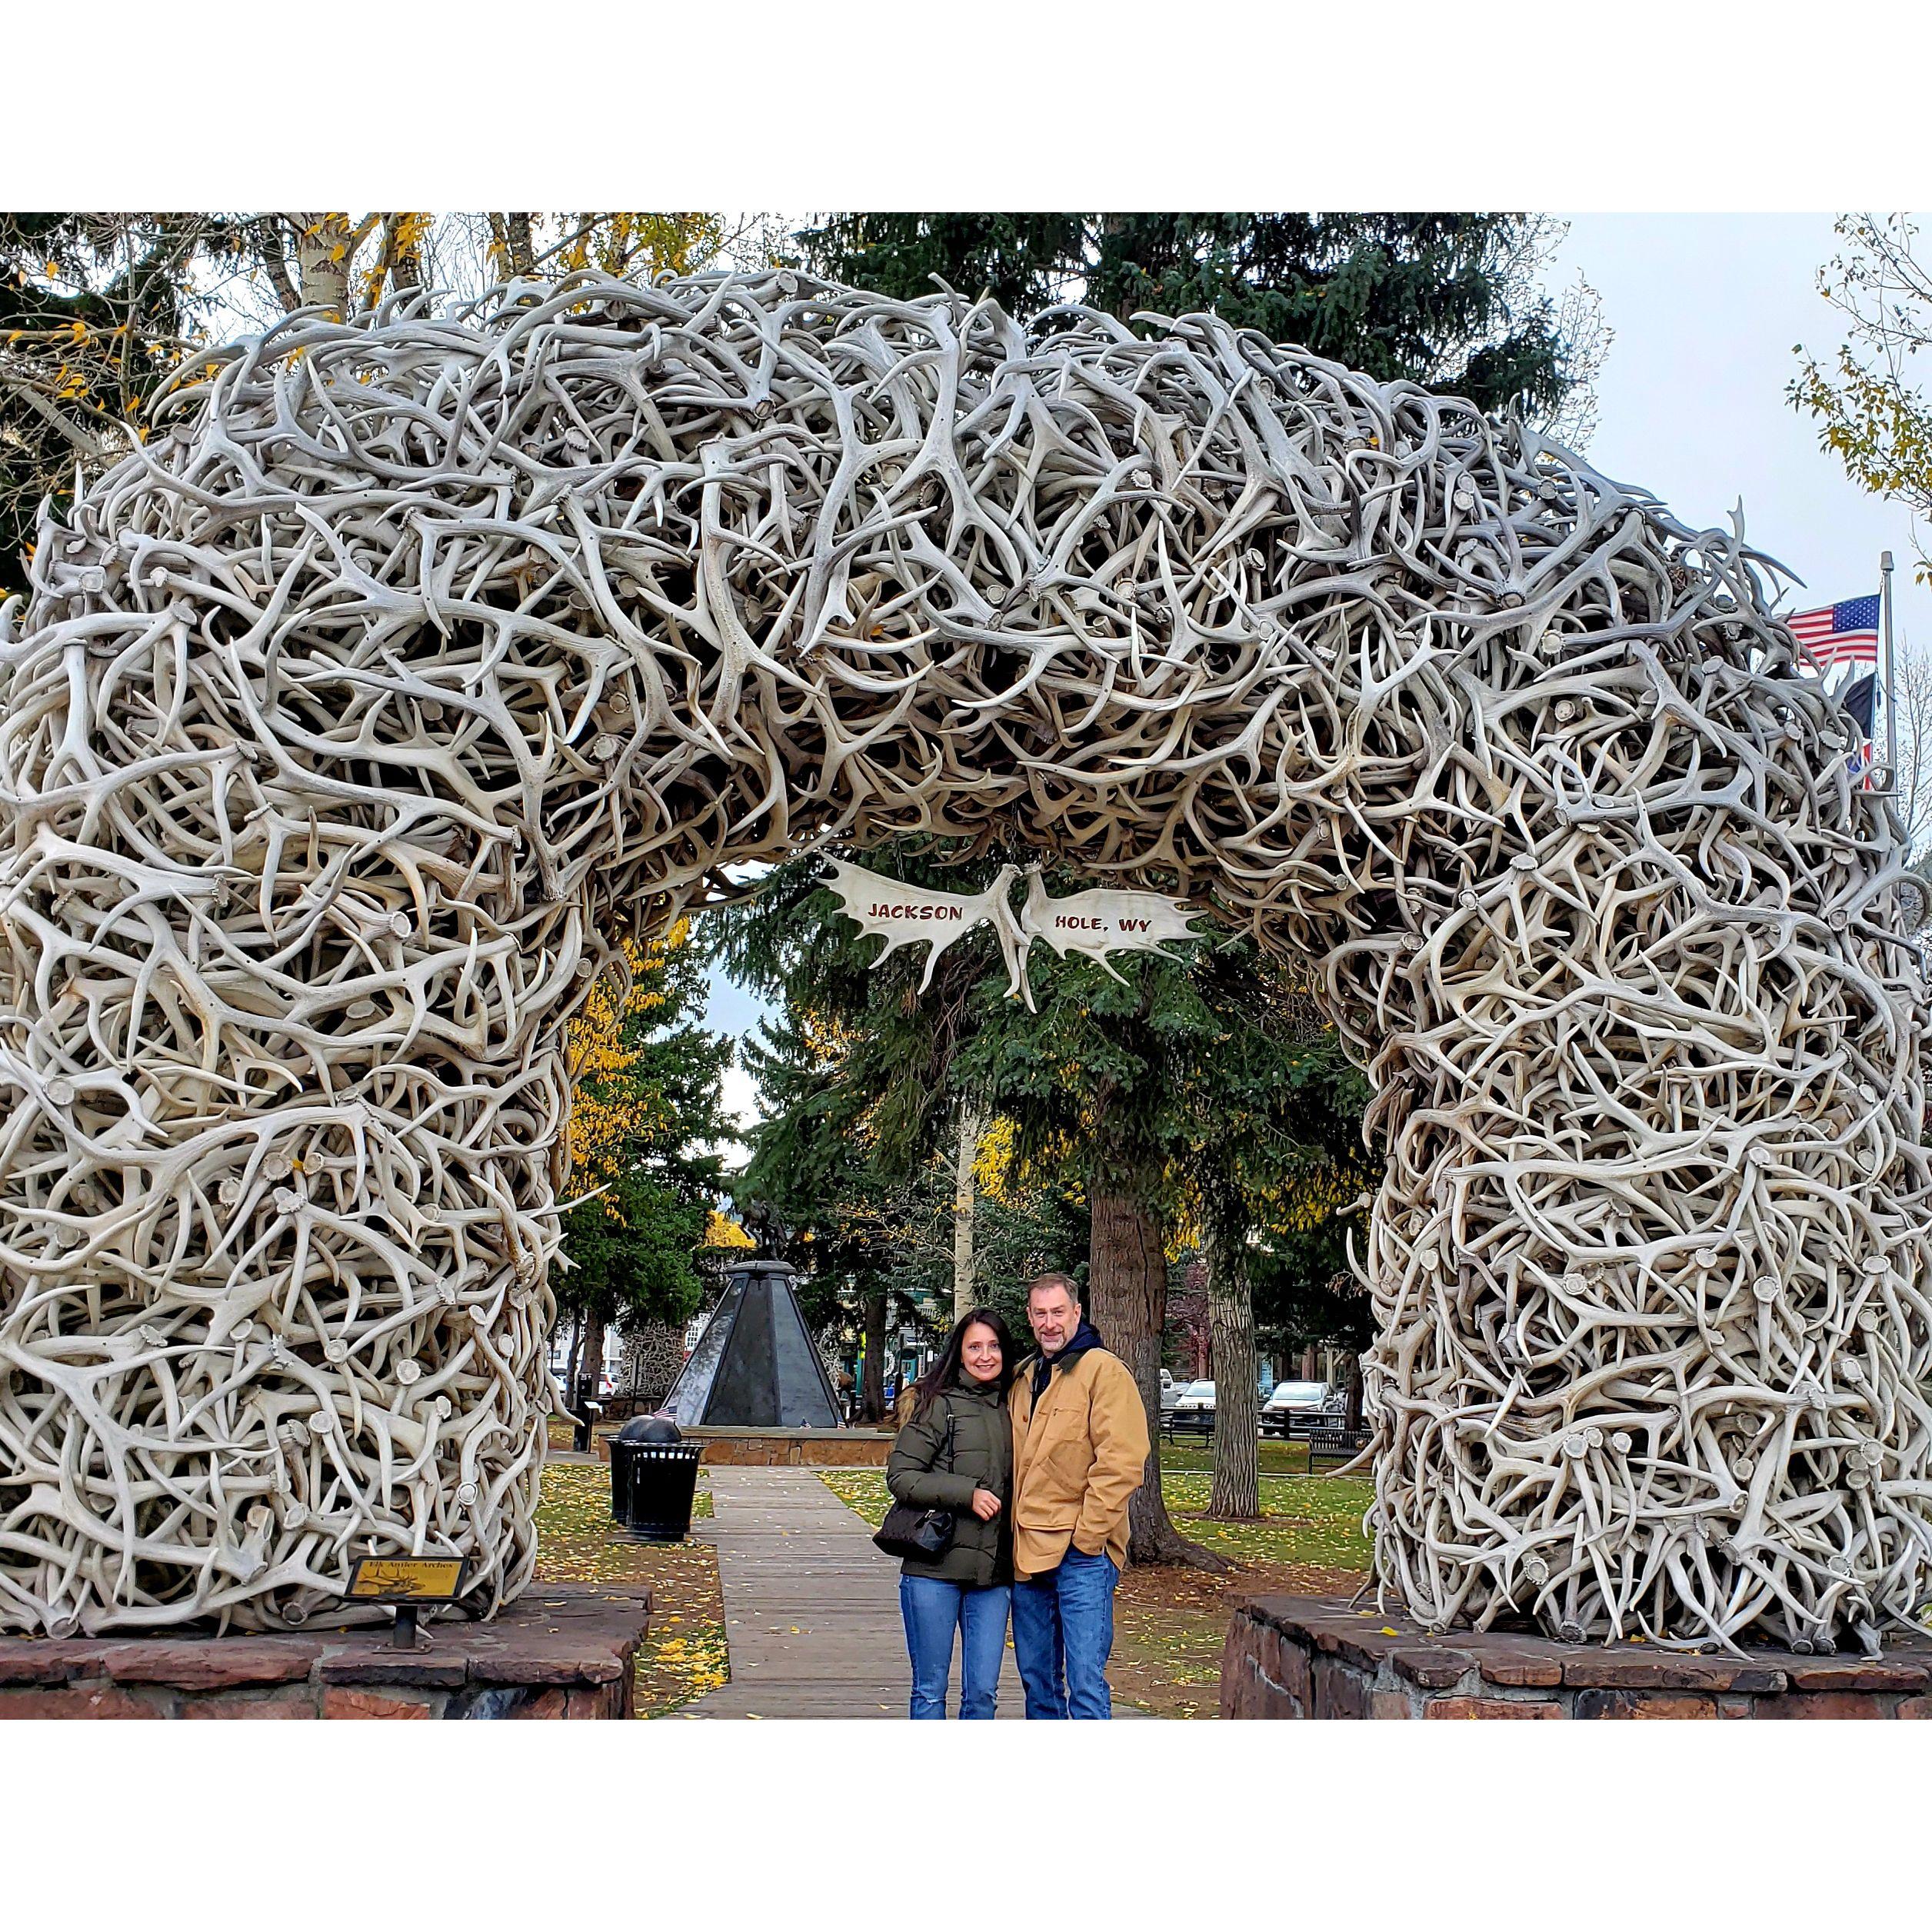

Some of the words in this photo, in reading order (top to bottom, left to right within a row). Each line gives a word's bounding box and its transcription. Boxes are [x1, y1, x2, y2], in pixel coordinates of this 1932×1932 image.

[868, 903, 963, 921] JACKSON
[1055, 915, 1109, 932] HOLE,
[1118, 918, 1152, 932] WY
